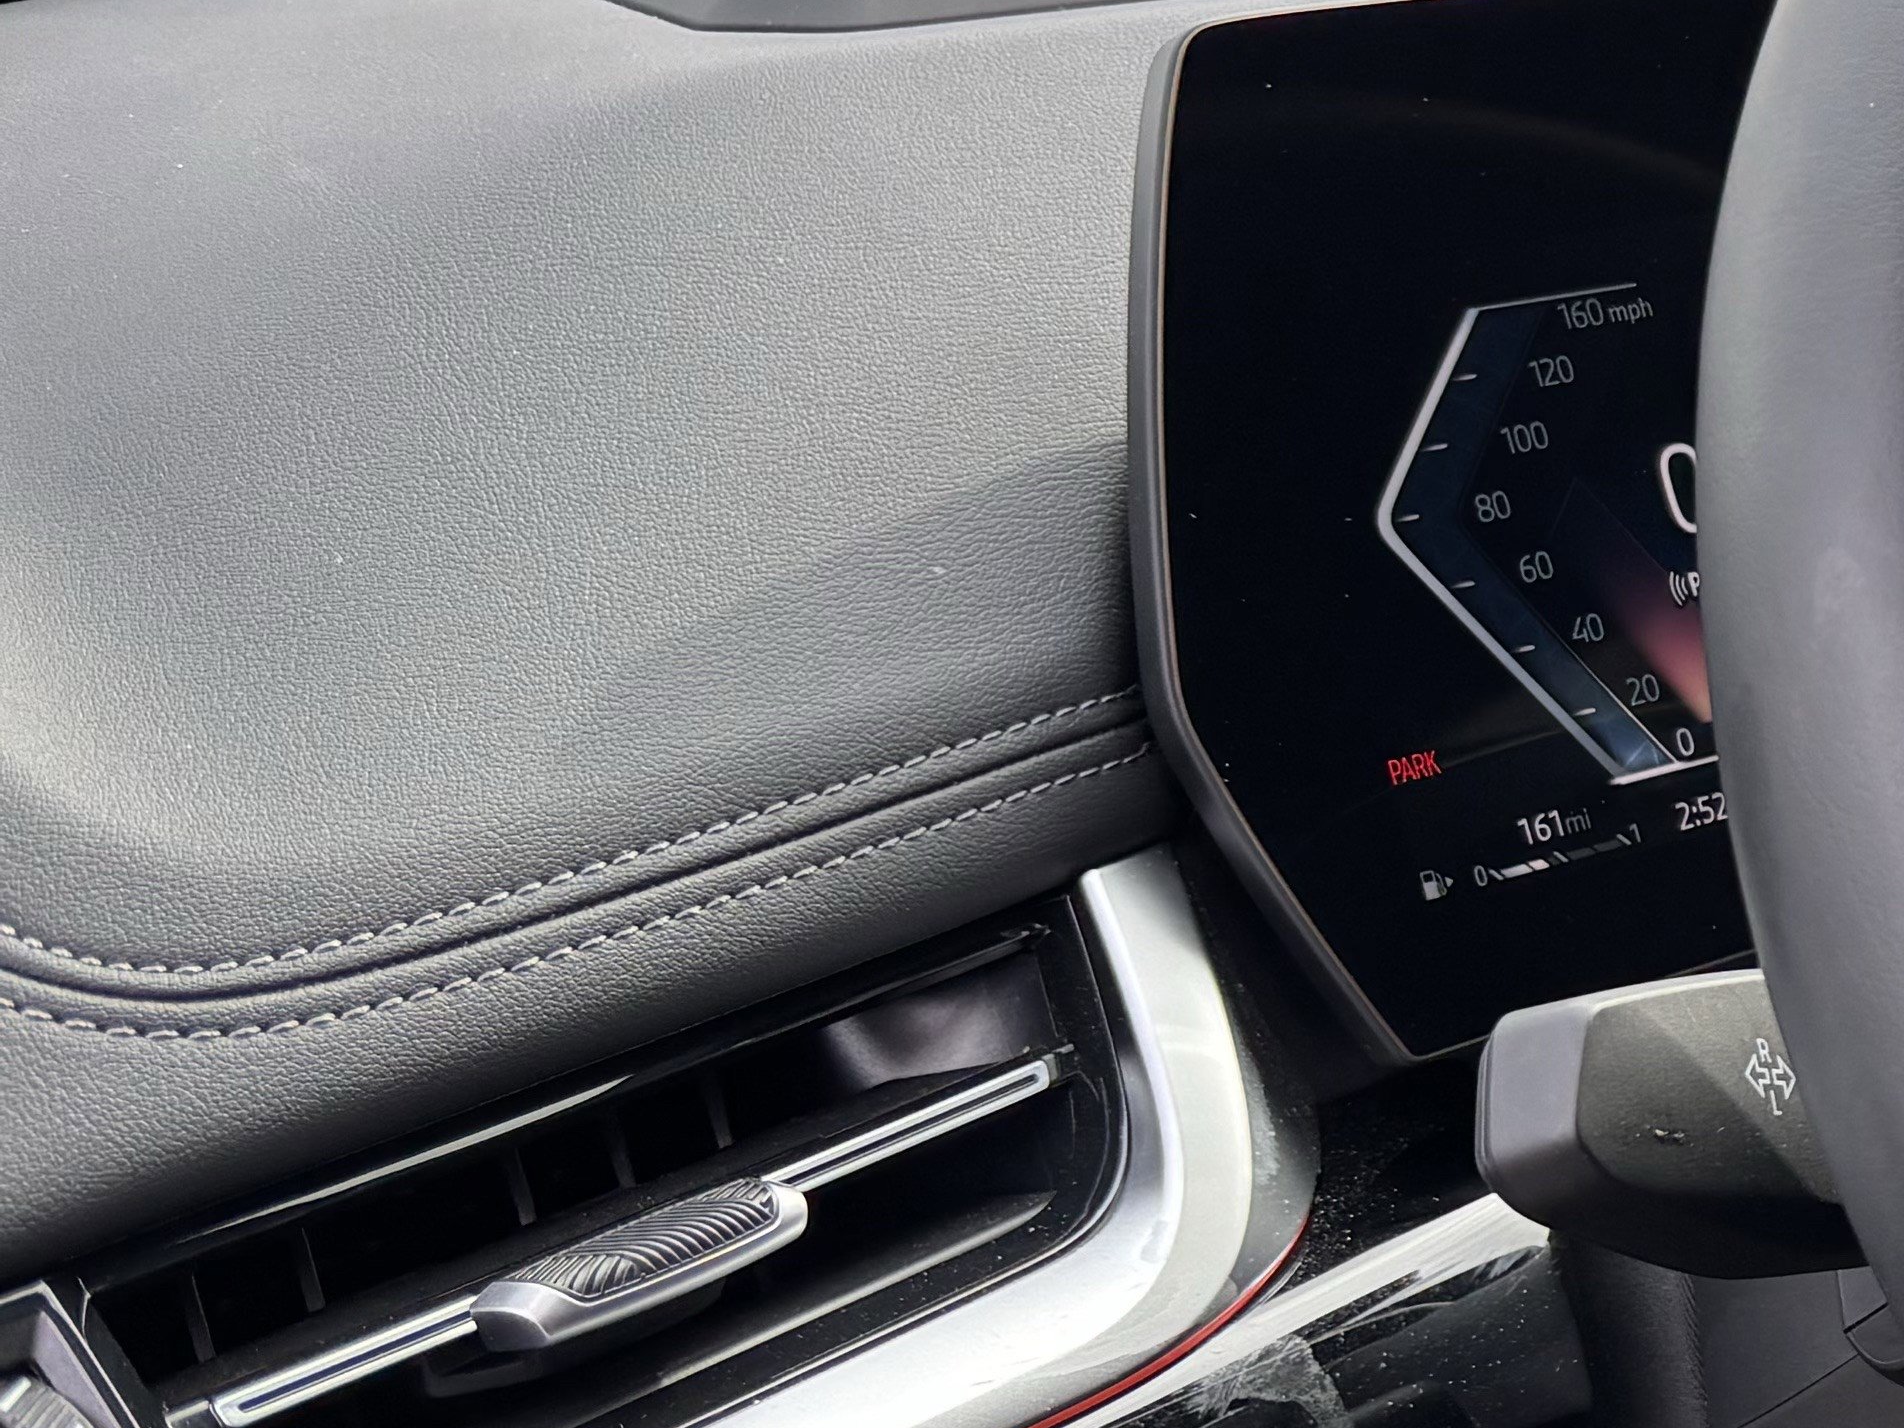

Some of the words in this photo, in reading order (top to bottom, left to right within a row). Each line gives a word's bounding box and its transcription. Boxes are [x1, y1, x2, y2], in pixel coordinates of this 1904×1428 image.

[1556, 297, 1604, 330] 160
[1607, 297, 1654, 325] mph
[1528, 354, 1575, 388] 120
[1499, 420, 1549, 454] 100
[1474, 490, 1512, 523] 80
[1518, 550, 1554, 584] 60
[1571, 612, 1605, 643] 40
[1625, 673, 1661, 707] 20
[1675, 727, 1695, 757] 0
[1386, 749, 1443, 786] PARK
[1516, 809, 1566, 845] 161
[1674, 791, 1729, 832] 2:52
[1473, 864, 1489, 887] 0
[1756, 1038, 1771, 1062] R
[1769, 1089, 1784, 1116] L
